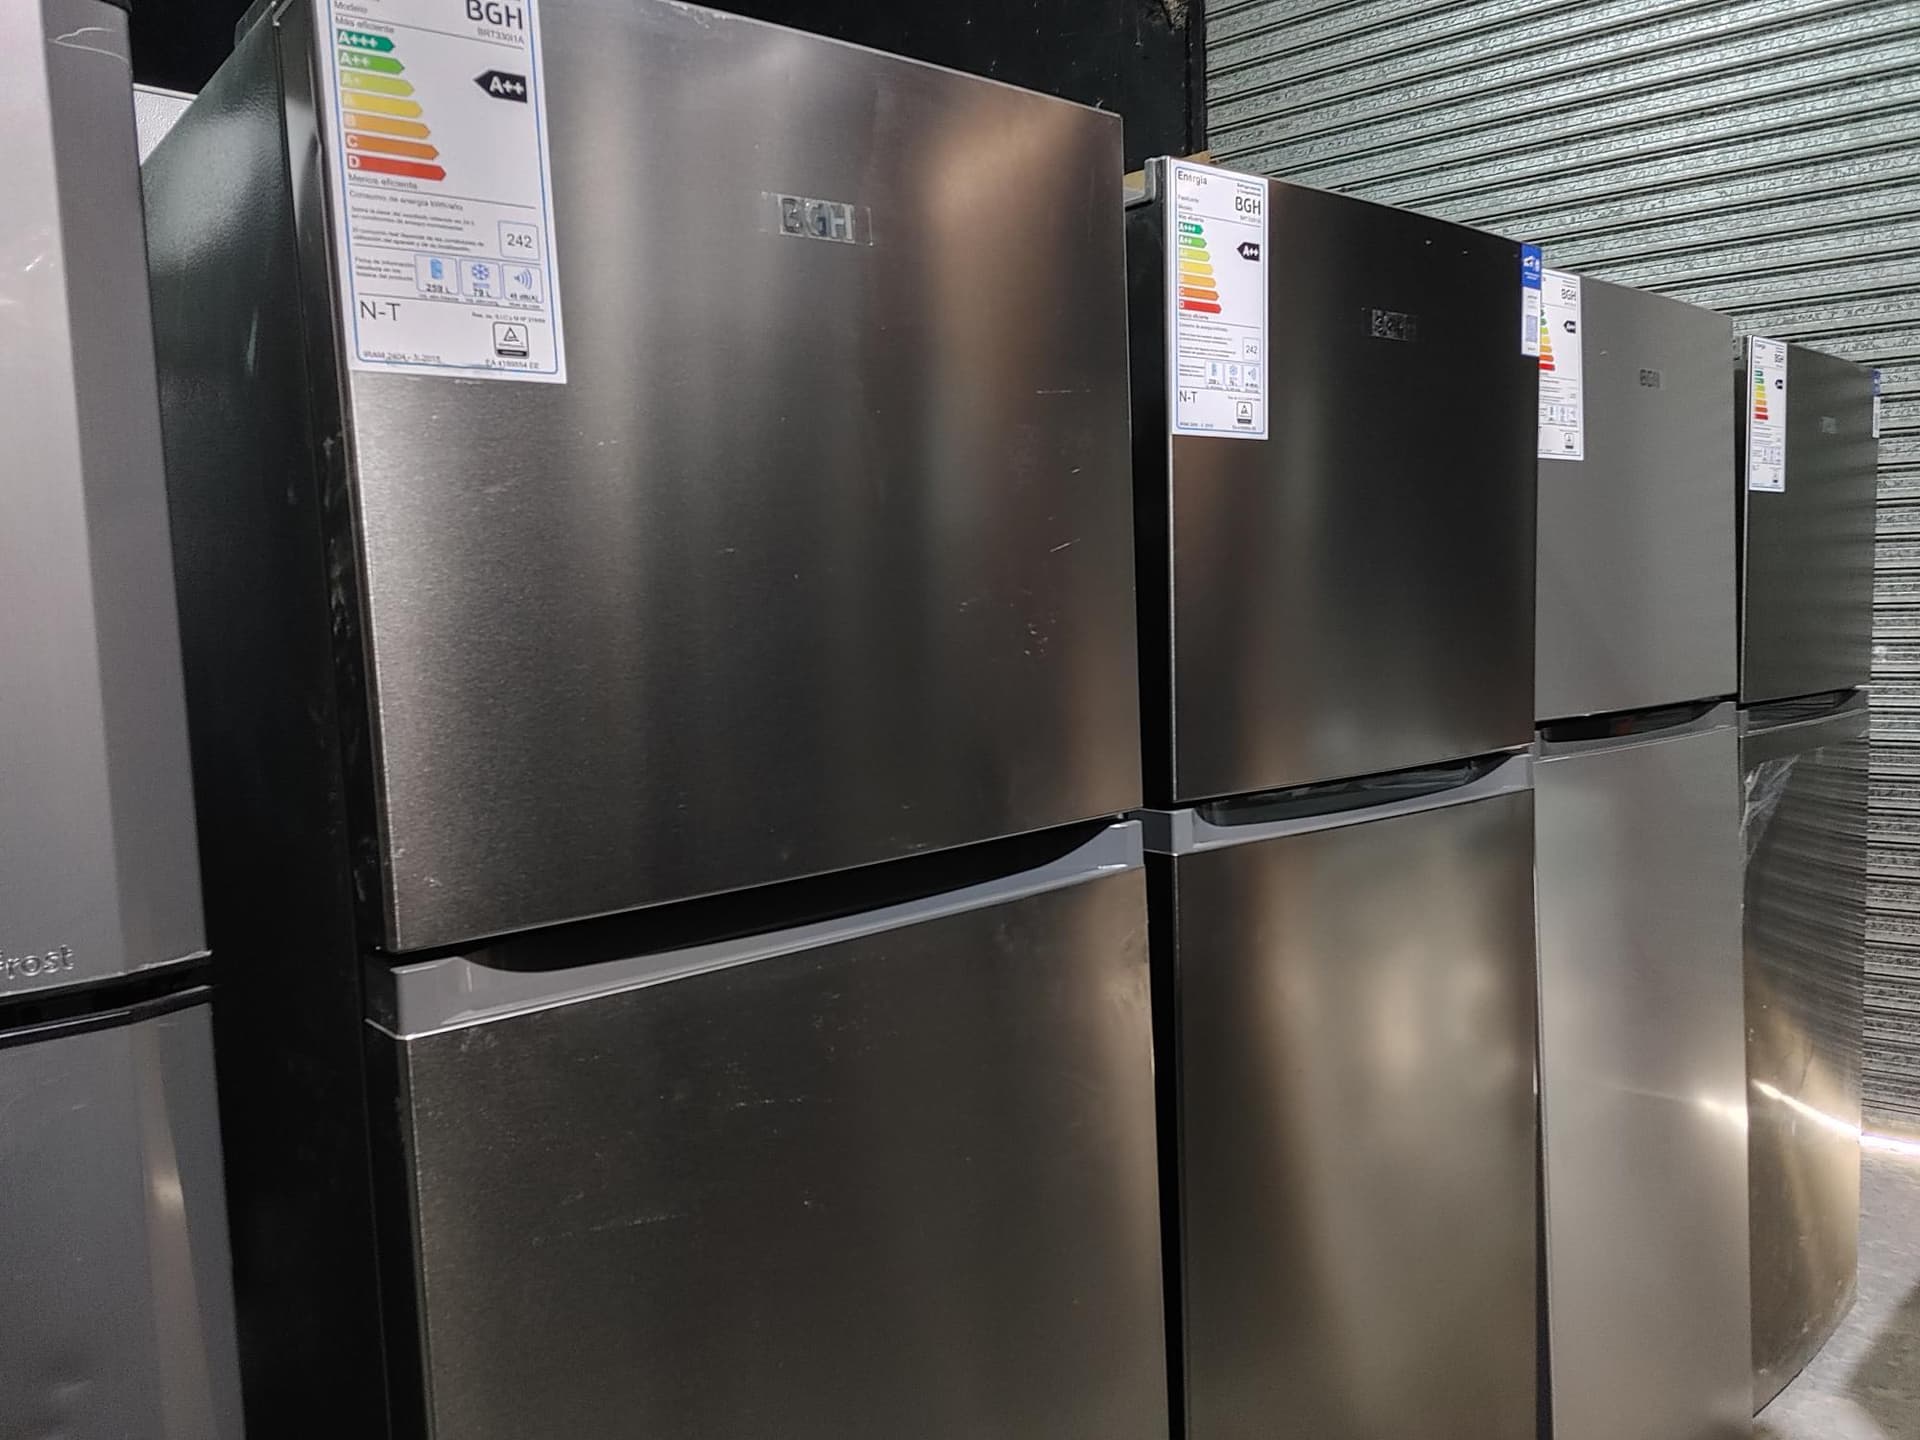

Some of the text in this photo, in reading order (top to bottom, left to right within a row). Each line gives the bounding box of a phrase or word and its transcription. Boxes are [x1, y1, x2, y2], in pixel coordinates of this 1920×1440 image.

[467, 0, 523, 30] BGH
[339, 31, 378, 48] A+++
[340, 52, 370, 66] A++
[489, 76, 524, 95] A++
[347, 134, 359, 148] C
[348, 154, 361, 169] D
[1235, 196, 1261, 216] BGH
[780, 198, 854, 241] BGH
[506, 233, 533, 250] 242
[1243, 246, 1259, 258] A++
[360, 300, 401, 322] N-T
[1245, 345, 1258, 355] 242
[1179, 390, 1198, 403] N-T
[0, 944, 74, 979] rost
